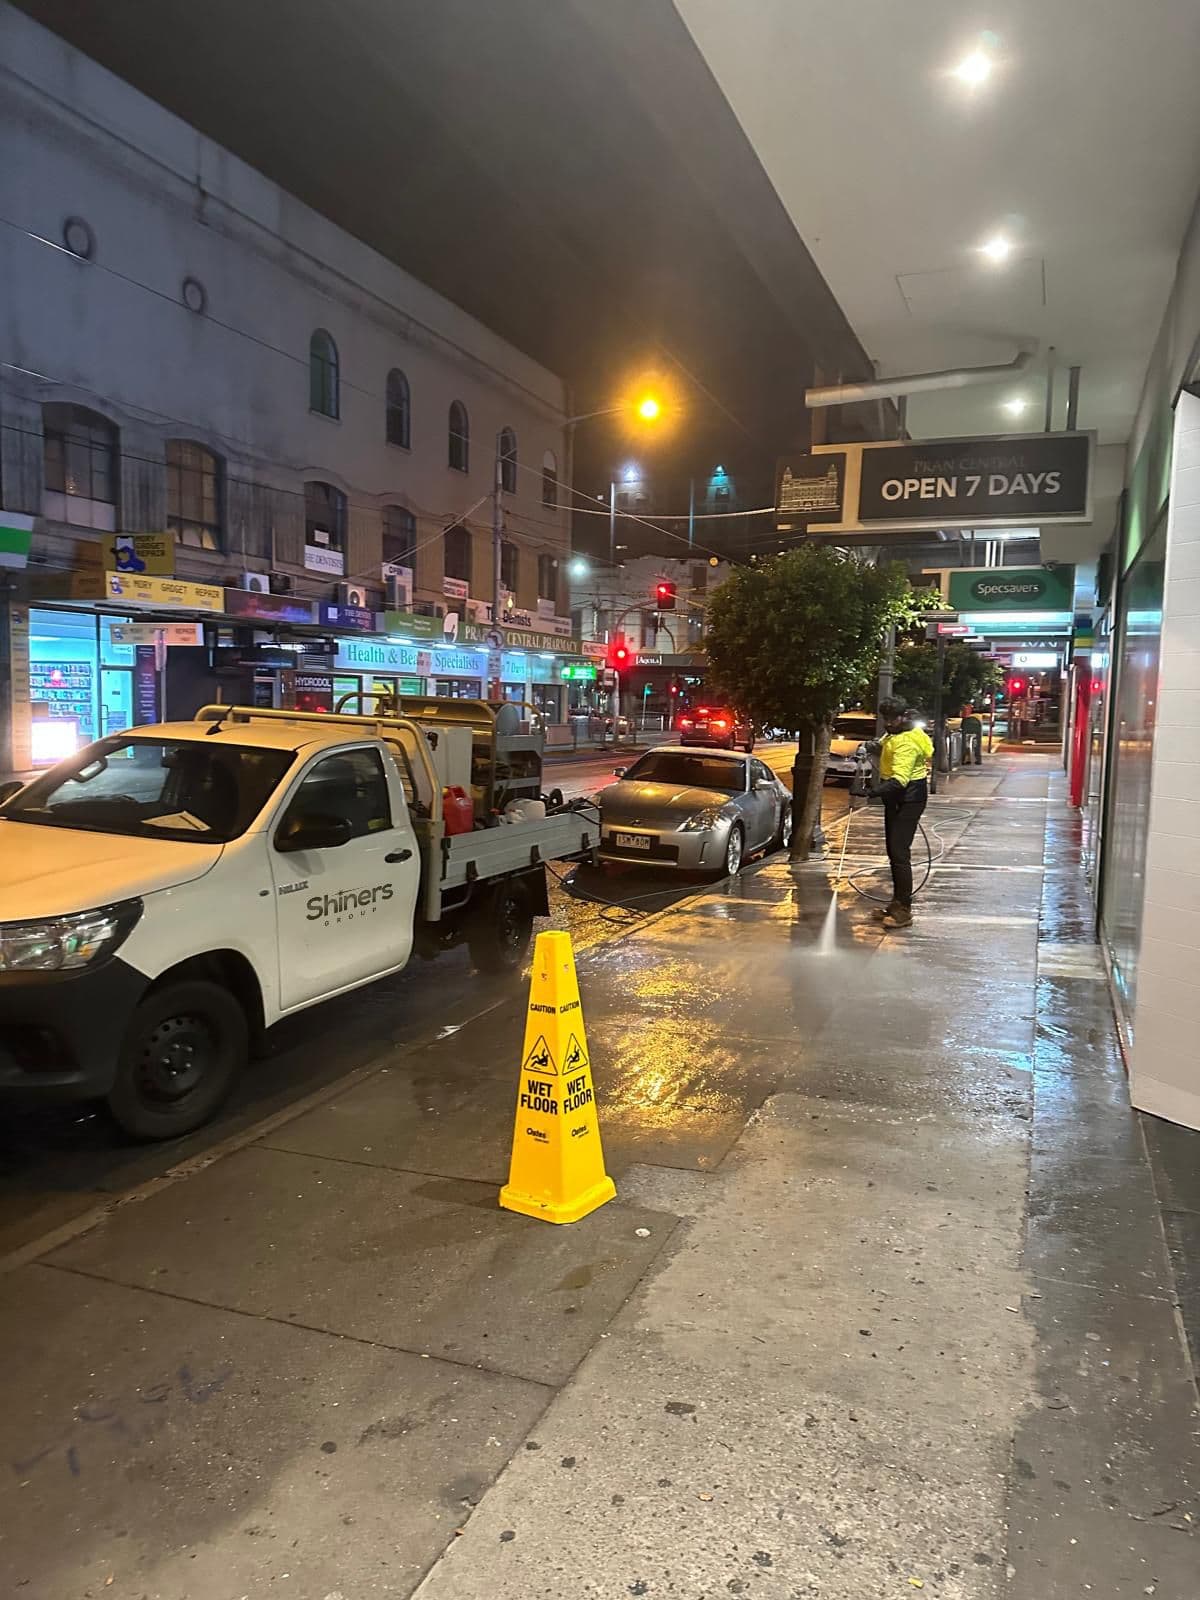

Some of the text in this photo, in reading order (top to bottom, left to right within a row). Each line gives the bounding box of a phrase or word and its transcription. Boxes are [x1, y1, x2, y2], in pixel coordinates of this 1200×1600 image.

[881, 471, 1062, 500] OPEN 7 DAYS
[160, 583, 187, 594] GADGET
[195, 588, 220, 599] REPAIR
[977, 583, 1039, 596] Specsavers
[502, 609, 532, 627] Dentists
[506, 631, 541, 648] CENTRAL
[542, 636, 578, 653] PHARMACY
[347, 643, 385, 663] Health
[388, 650, 398, 664] &
[434, 652, 480, 672] Specialists
[306, 882, 394, 921] Shiners
[323, 906, 377, 927] GROUP
[530, 1003, 556, 1014] CAUTION
[559, 1000, 580, 1013] CAUTION
[527, 1079, 553, 1097] WET
[567, 1075, 586, 1095] WET
[520, 1094, 558, 1115] FLOOR
[563, 1088, 592, 1114] FLOOR
